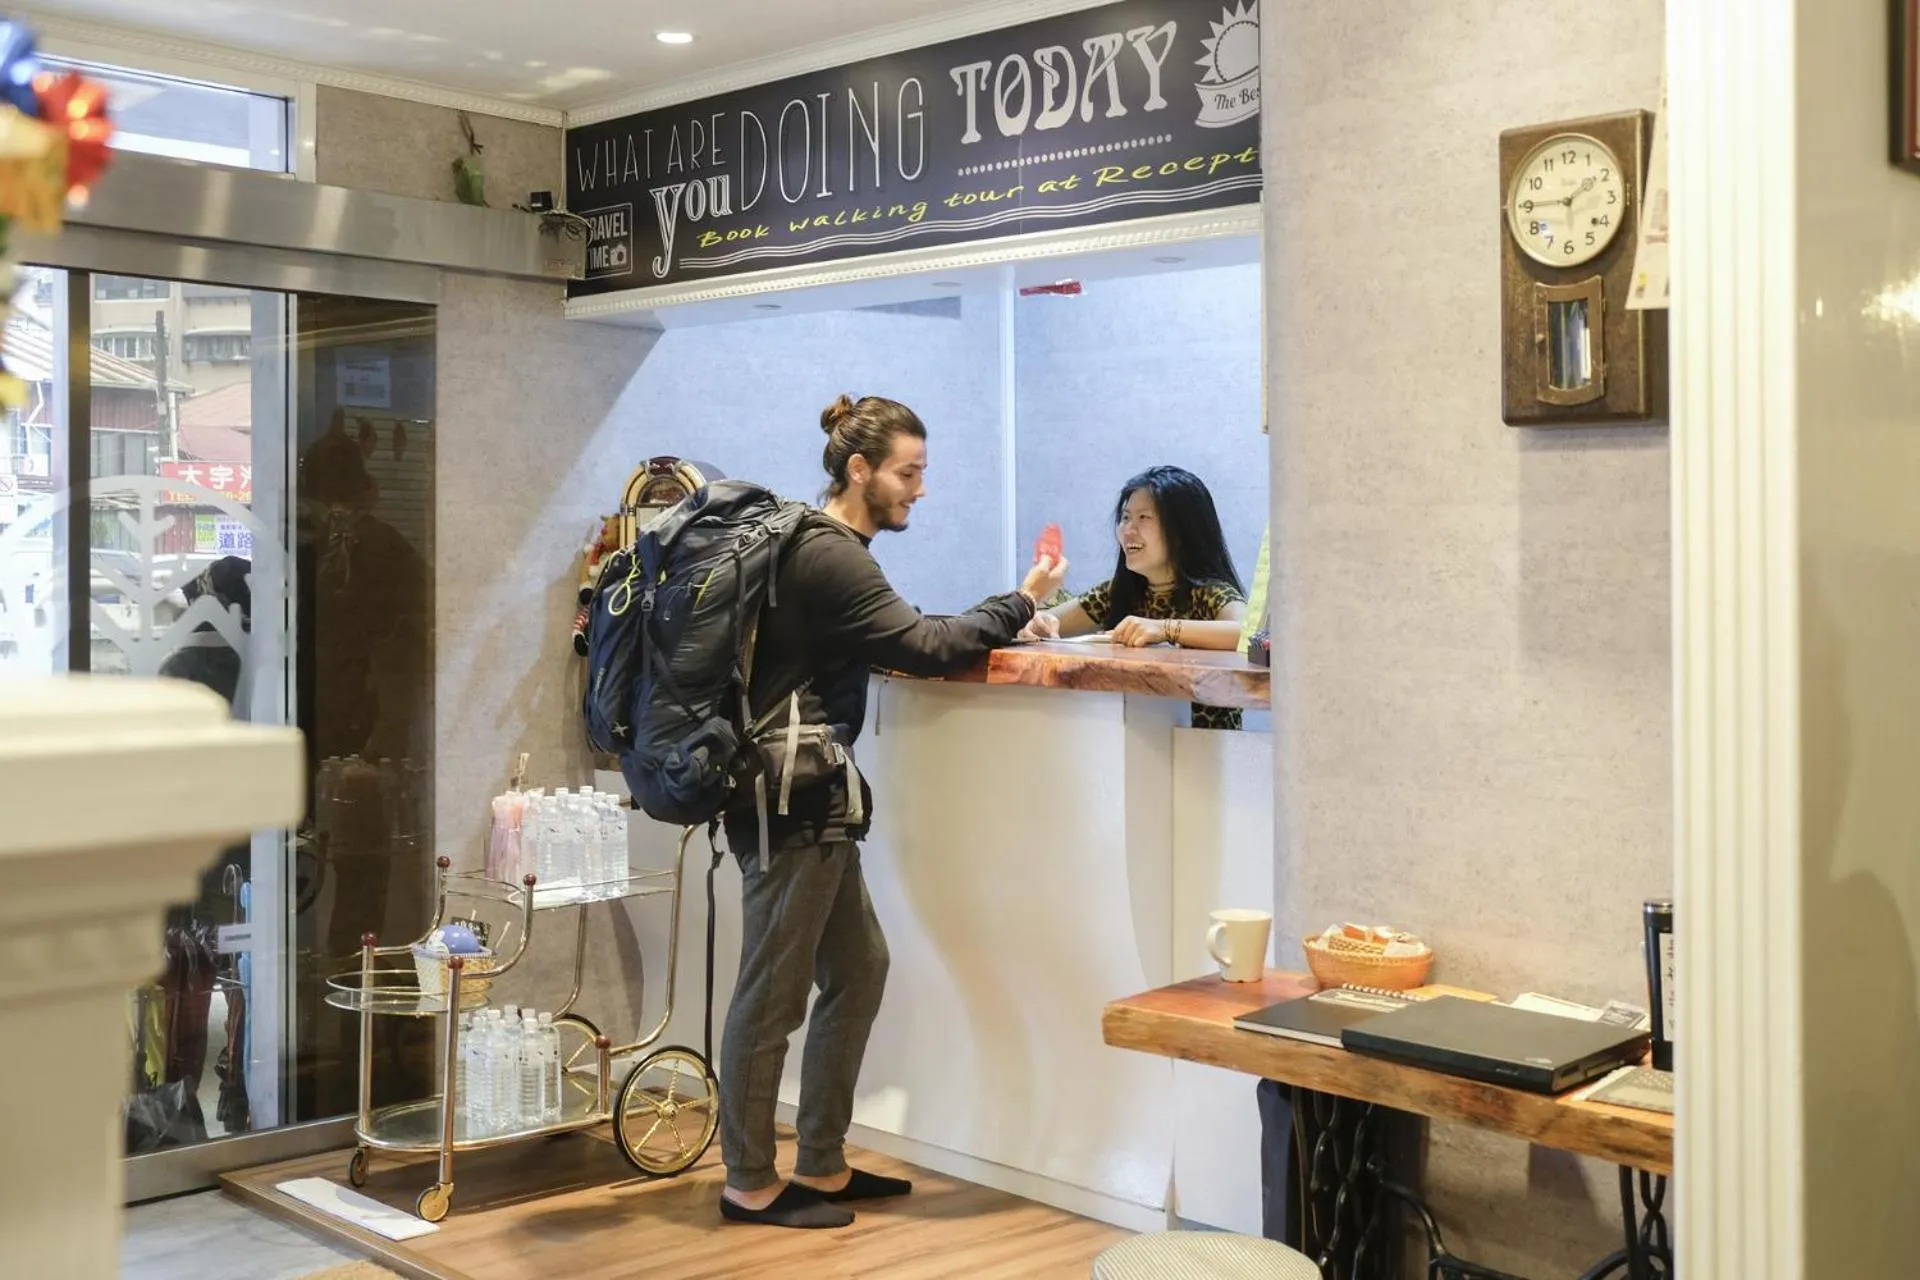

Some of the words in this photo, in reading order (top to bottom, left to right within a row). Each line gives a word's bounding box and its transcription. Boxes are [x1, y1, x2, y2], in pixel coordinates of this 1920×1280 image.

[1214, 93, 1236, 111] The
[576, 129, 654, 192] WHAT
[667, 112, 728, 174] ARE
[741, 77, 924, 211] DOING
[949, 20, 1178, 144] TODAY
[1543, 158, 1554, 172] 11
[1561, 150, 1577, 165] 12
[1585, 153, 1591, 166] 1
[1600, 168, 1610, 182] 2
[1529, 176, 1543, 191] 10
[697, 222, 770, 248] Book
[789, 201, 929, 233] walking
[944, 185, 1024, 208] tour
[1038, 174, 1082, 191] at
[1094, 147, 1259, 188] Recept
[1607, 190, 1617, 205] 3
[1523, 200, 1534, 213] 9
[589, 212, 628, 240] RAVEL
[650, 174, 734, 279] you
[1529, 220, 1540, 236] 8
[1599, 214, 1610, 228] 4
[1544, 235, 1554, 250] 7
[1585, 232, 1595, 246] 5
[1563, 240, 1575, 255] 6
